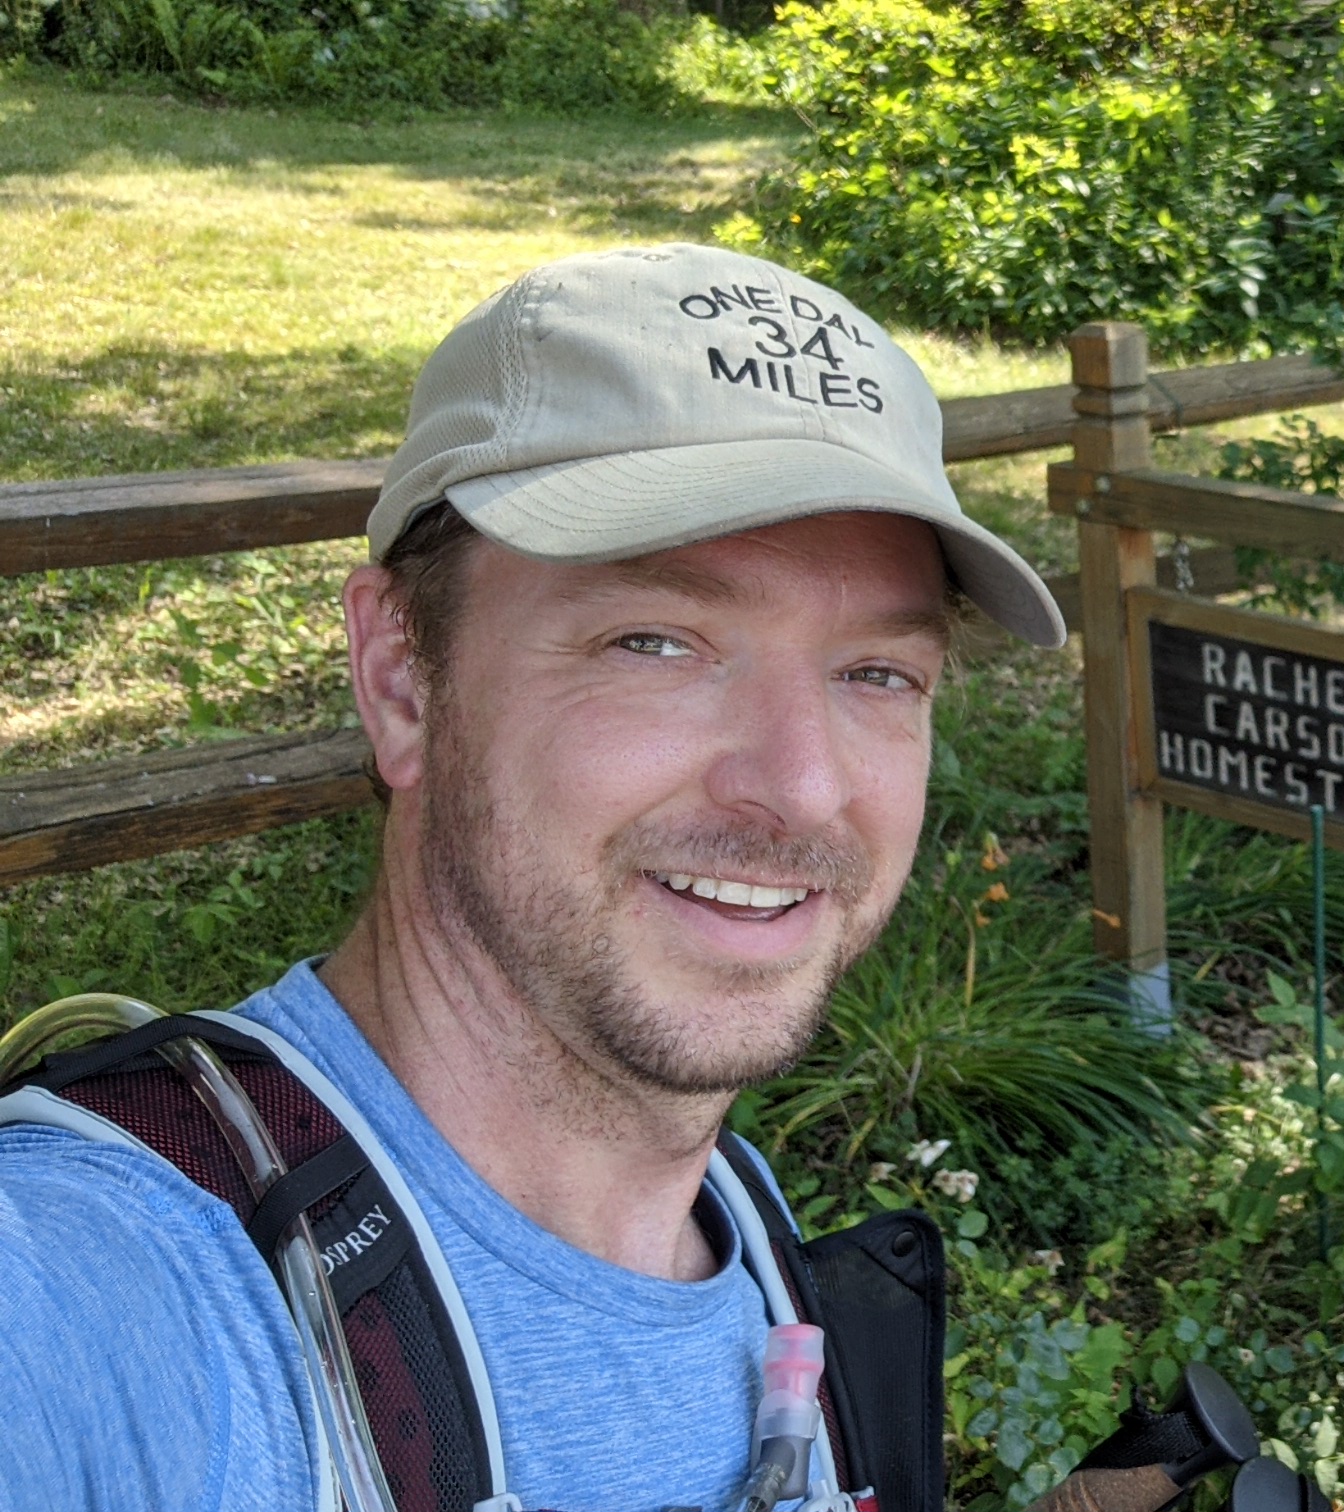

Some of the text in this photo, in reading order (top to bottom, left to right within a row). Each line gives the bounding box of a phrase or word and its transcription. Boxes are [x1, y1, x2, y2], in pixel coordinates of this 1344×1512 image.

[679, 284, 782, 320] ONE
[748, 315, 844, 371] 34
[707, 346, 883, 414] MILES
